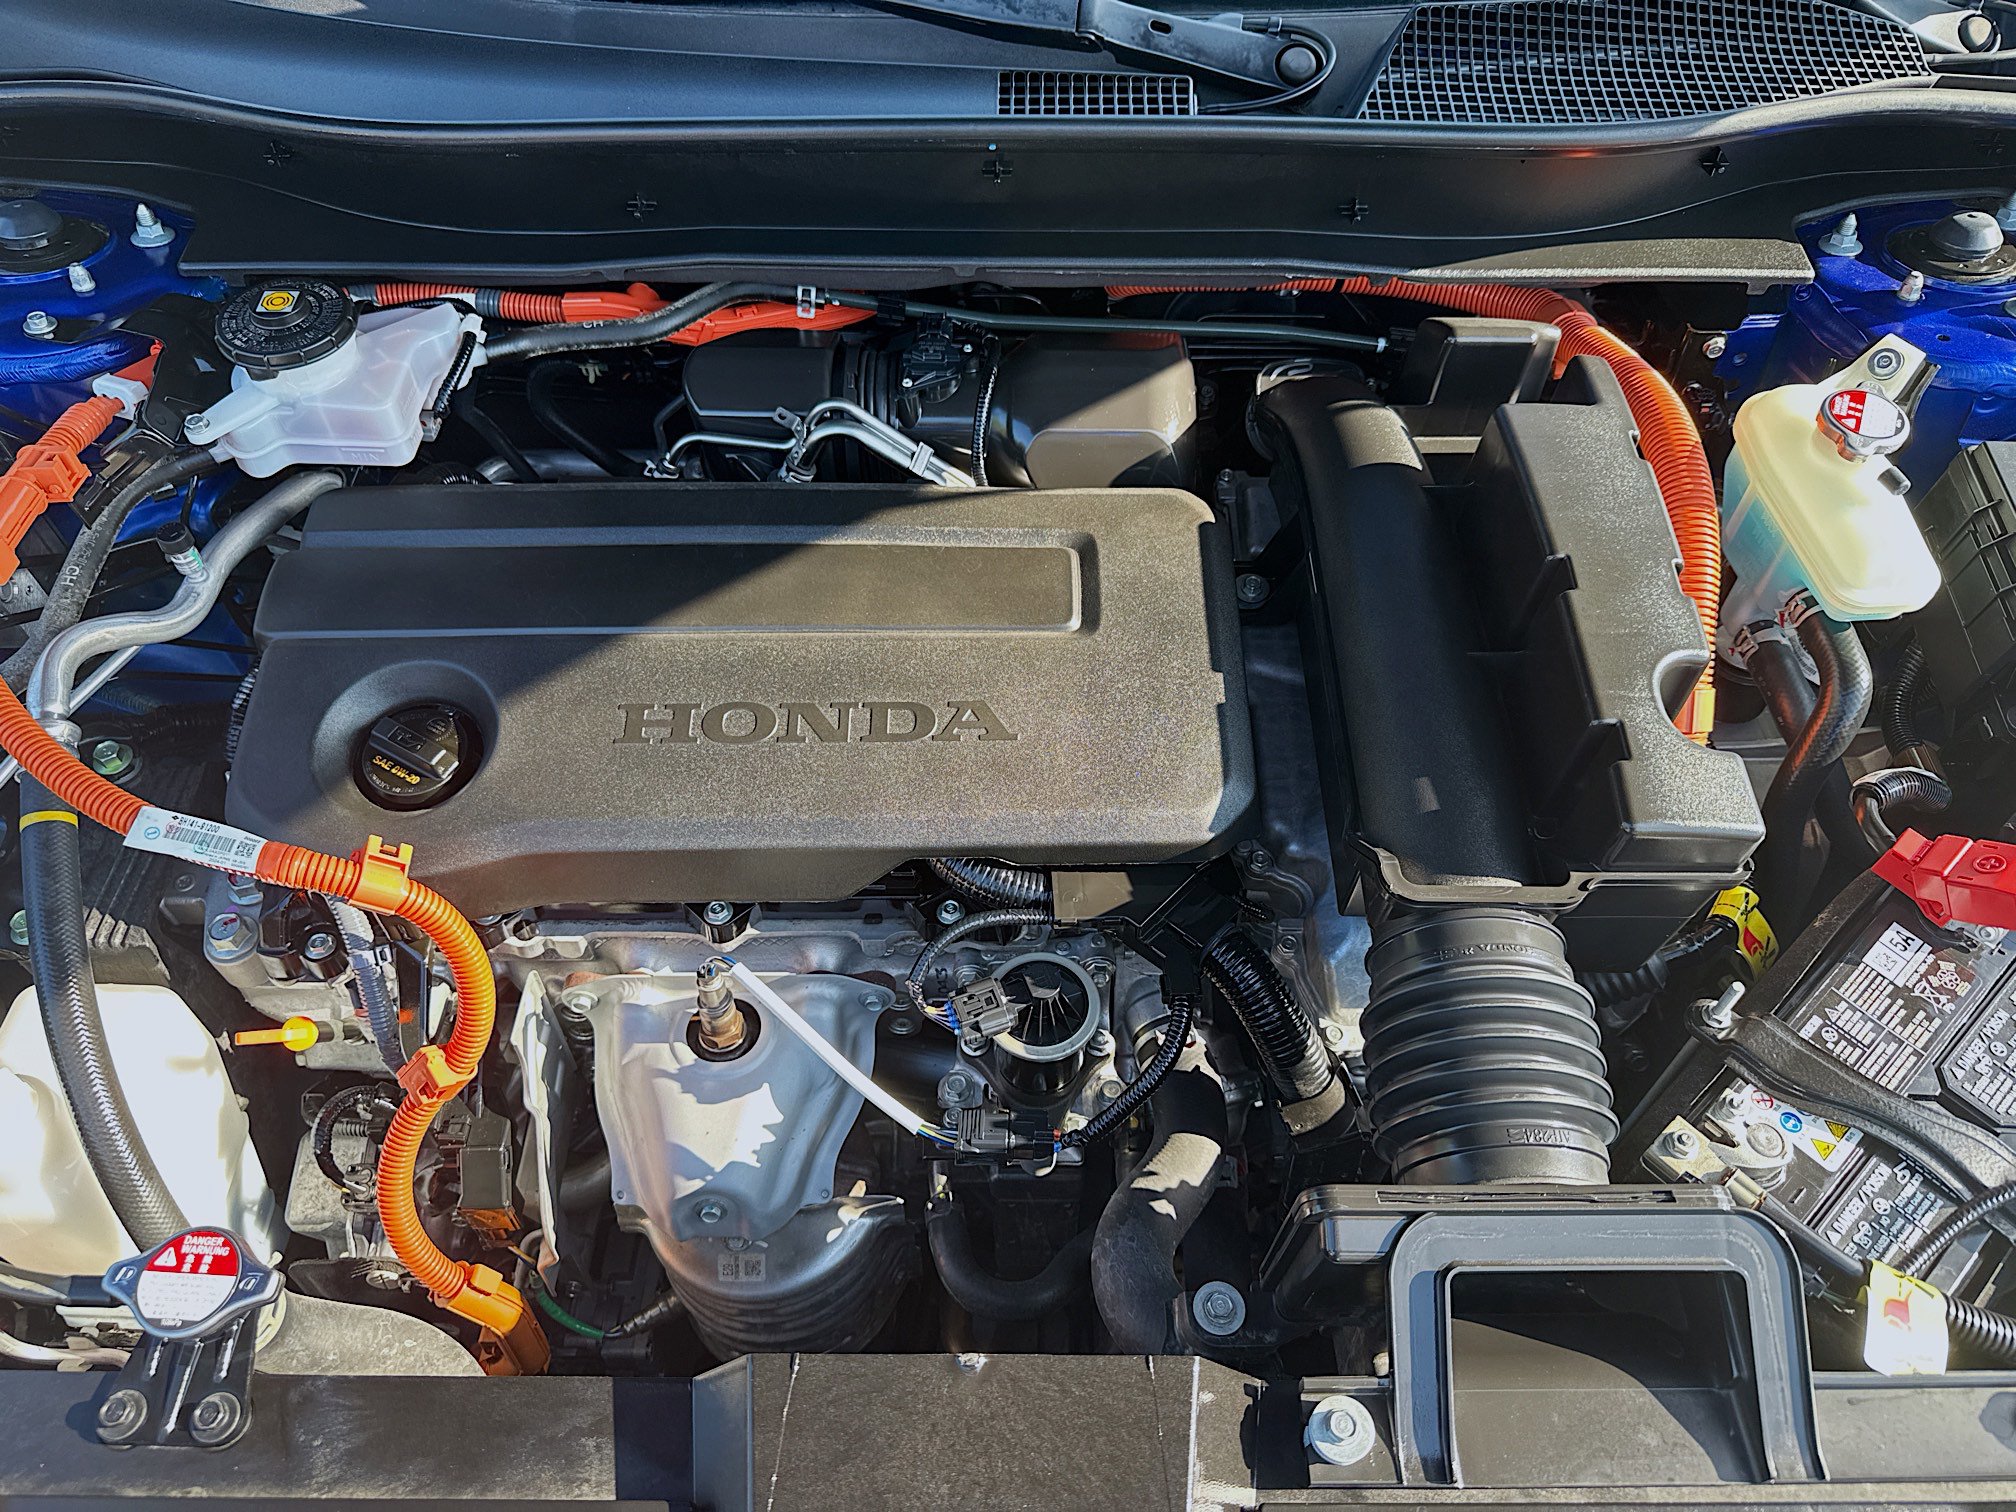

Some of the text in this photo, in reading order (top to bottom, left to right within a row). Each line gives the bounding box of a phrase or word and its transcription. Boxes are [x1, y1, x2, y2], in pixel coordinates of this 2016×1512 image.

[612, 700, 1021, 745] HONDA
[372, 755, 395, 771] SAE
[390, 765, 421, 785] 0W-20
[1889, 929, 1916, 953] 5A
[181, 1244, 231, 1257] WARNUNG
[183, 1235, 225, 1247] DANGER
